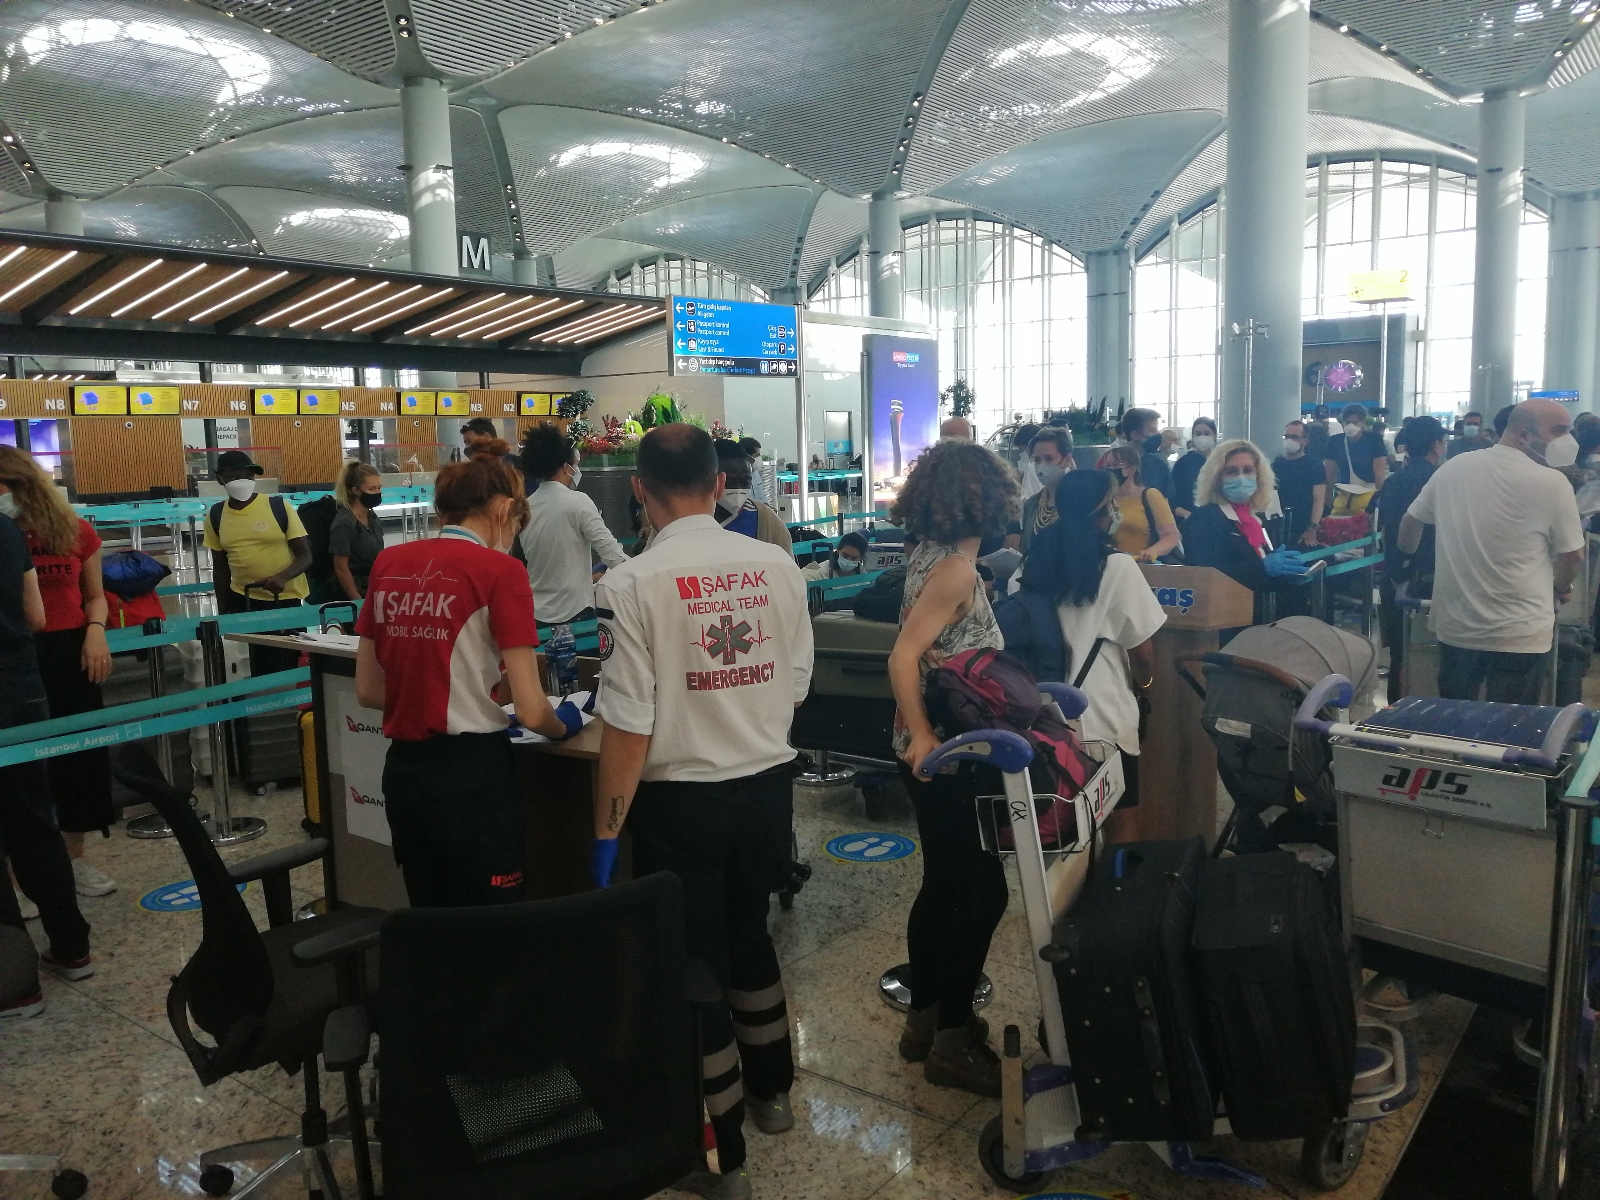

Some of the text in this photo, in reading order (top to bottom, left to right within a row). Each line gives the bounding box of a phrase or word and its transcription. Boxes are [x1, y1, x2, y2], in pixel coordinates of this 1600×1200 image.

[461, 235, 491, 271] M
[1399, 269, 1408, 283] 2
[45, 398, 66, 410] N8
[183, 400, 200, 411] N7
[230, 400, 247, 411] N6
[341, 401, 356, 412] N5
[380, 402, 394, 412] N4
[470, 403, 483, 412] N3
[503, 402, 515, 412] N2
[701, 570, 768, 598] ŞAFAK
[386, 591, 457, 623] ŞAFAK
[687, 594, 769, 616] MEDICAL TEAM
[1151, 587, 1195, 616] aş
[685, 660, 775, 691] EMERGENCY
[83, 732, 119, 748] Airport
